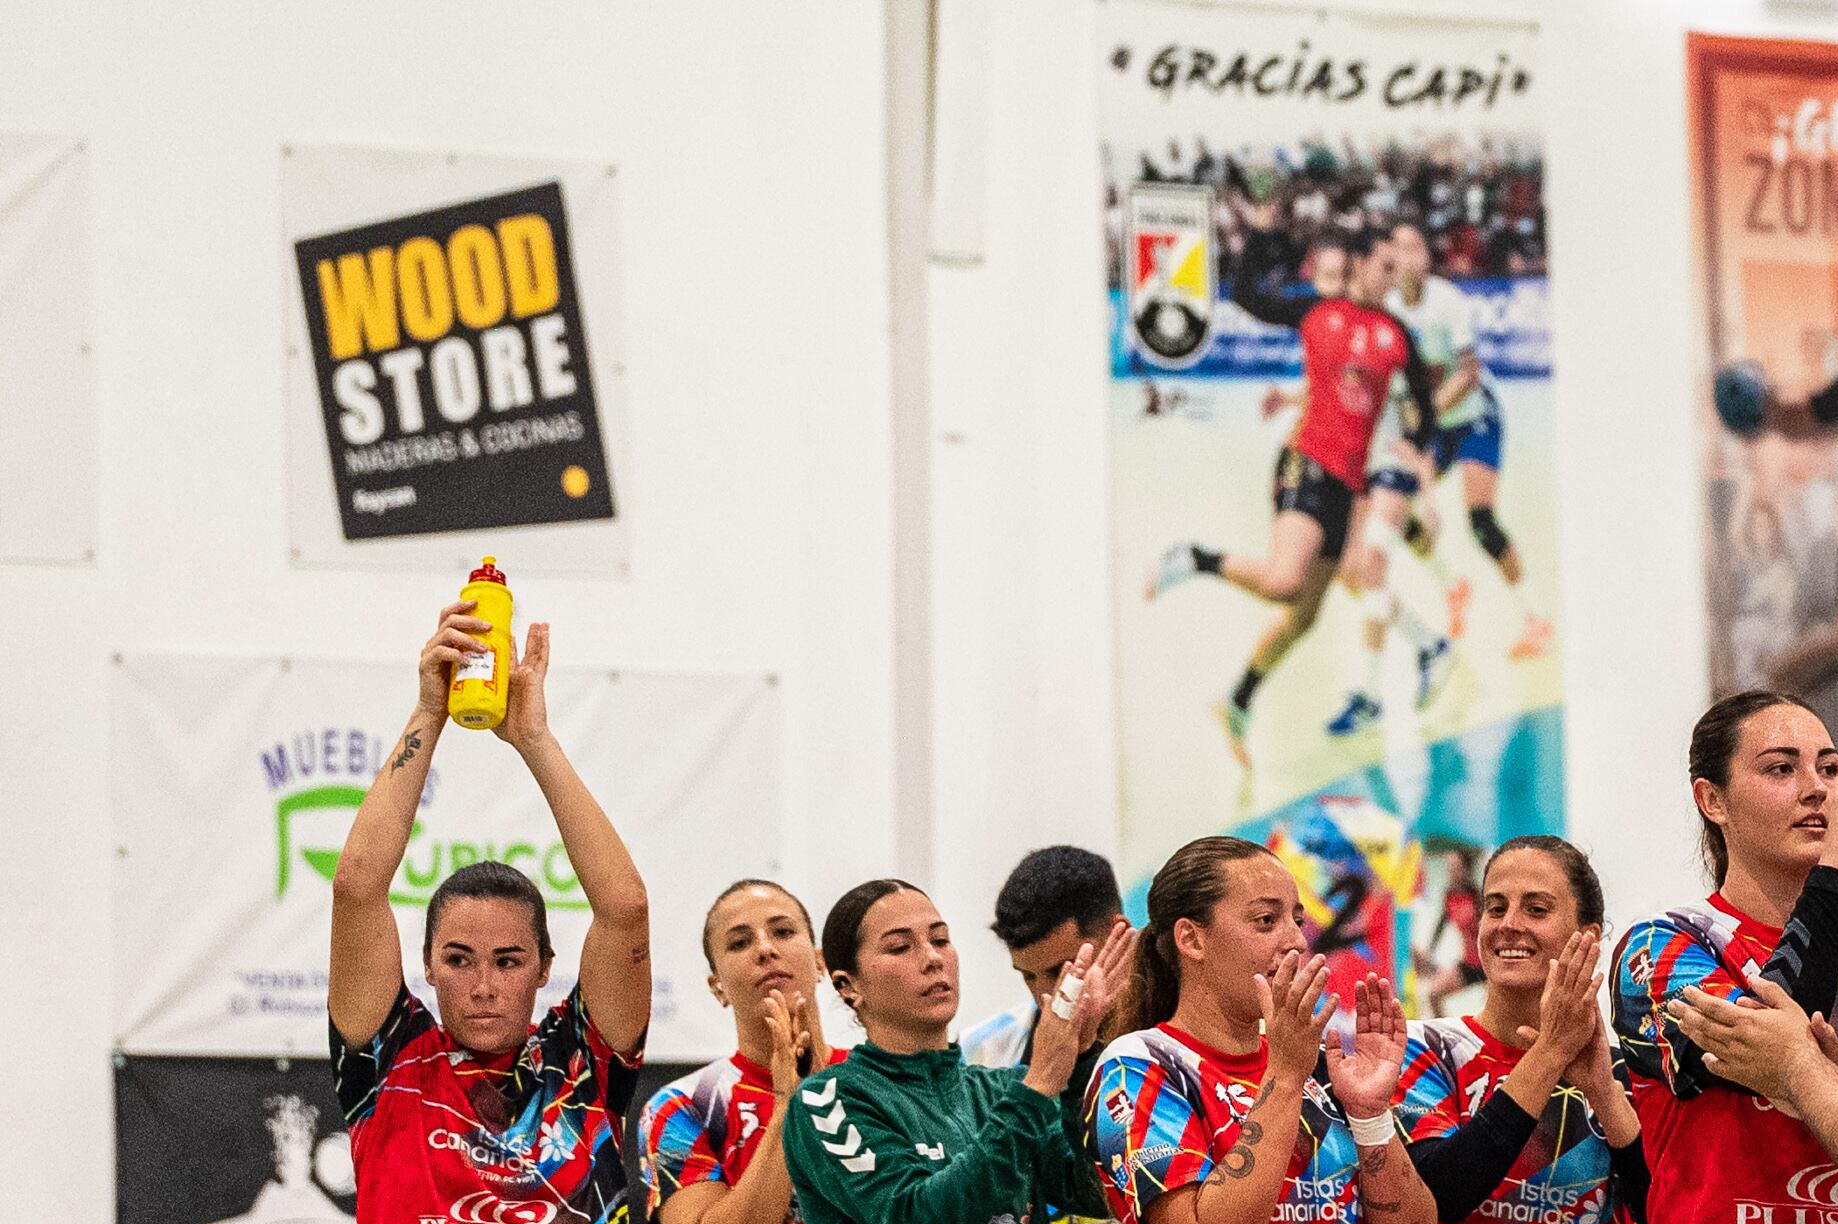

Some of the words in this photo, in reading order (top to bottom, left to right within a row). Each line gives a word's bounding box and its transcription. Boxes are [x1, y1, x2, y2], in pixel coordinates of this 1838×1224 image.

[317, 214, 558, 361] WOOD
[333, 316, 576, 445] STORE
[1271, 1200, 1348, 1222] anarias
